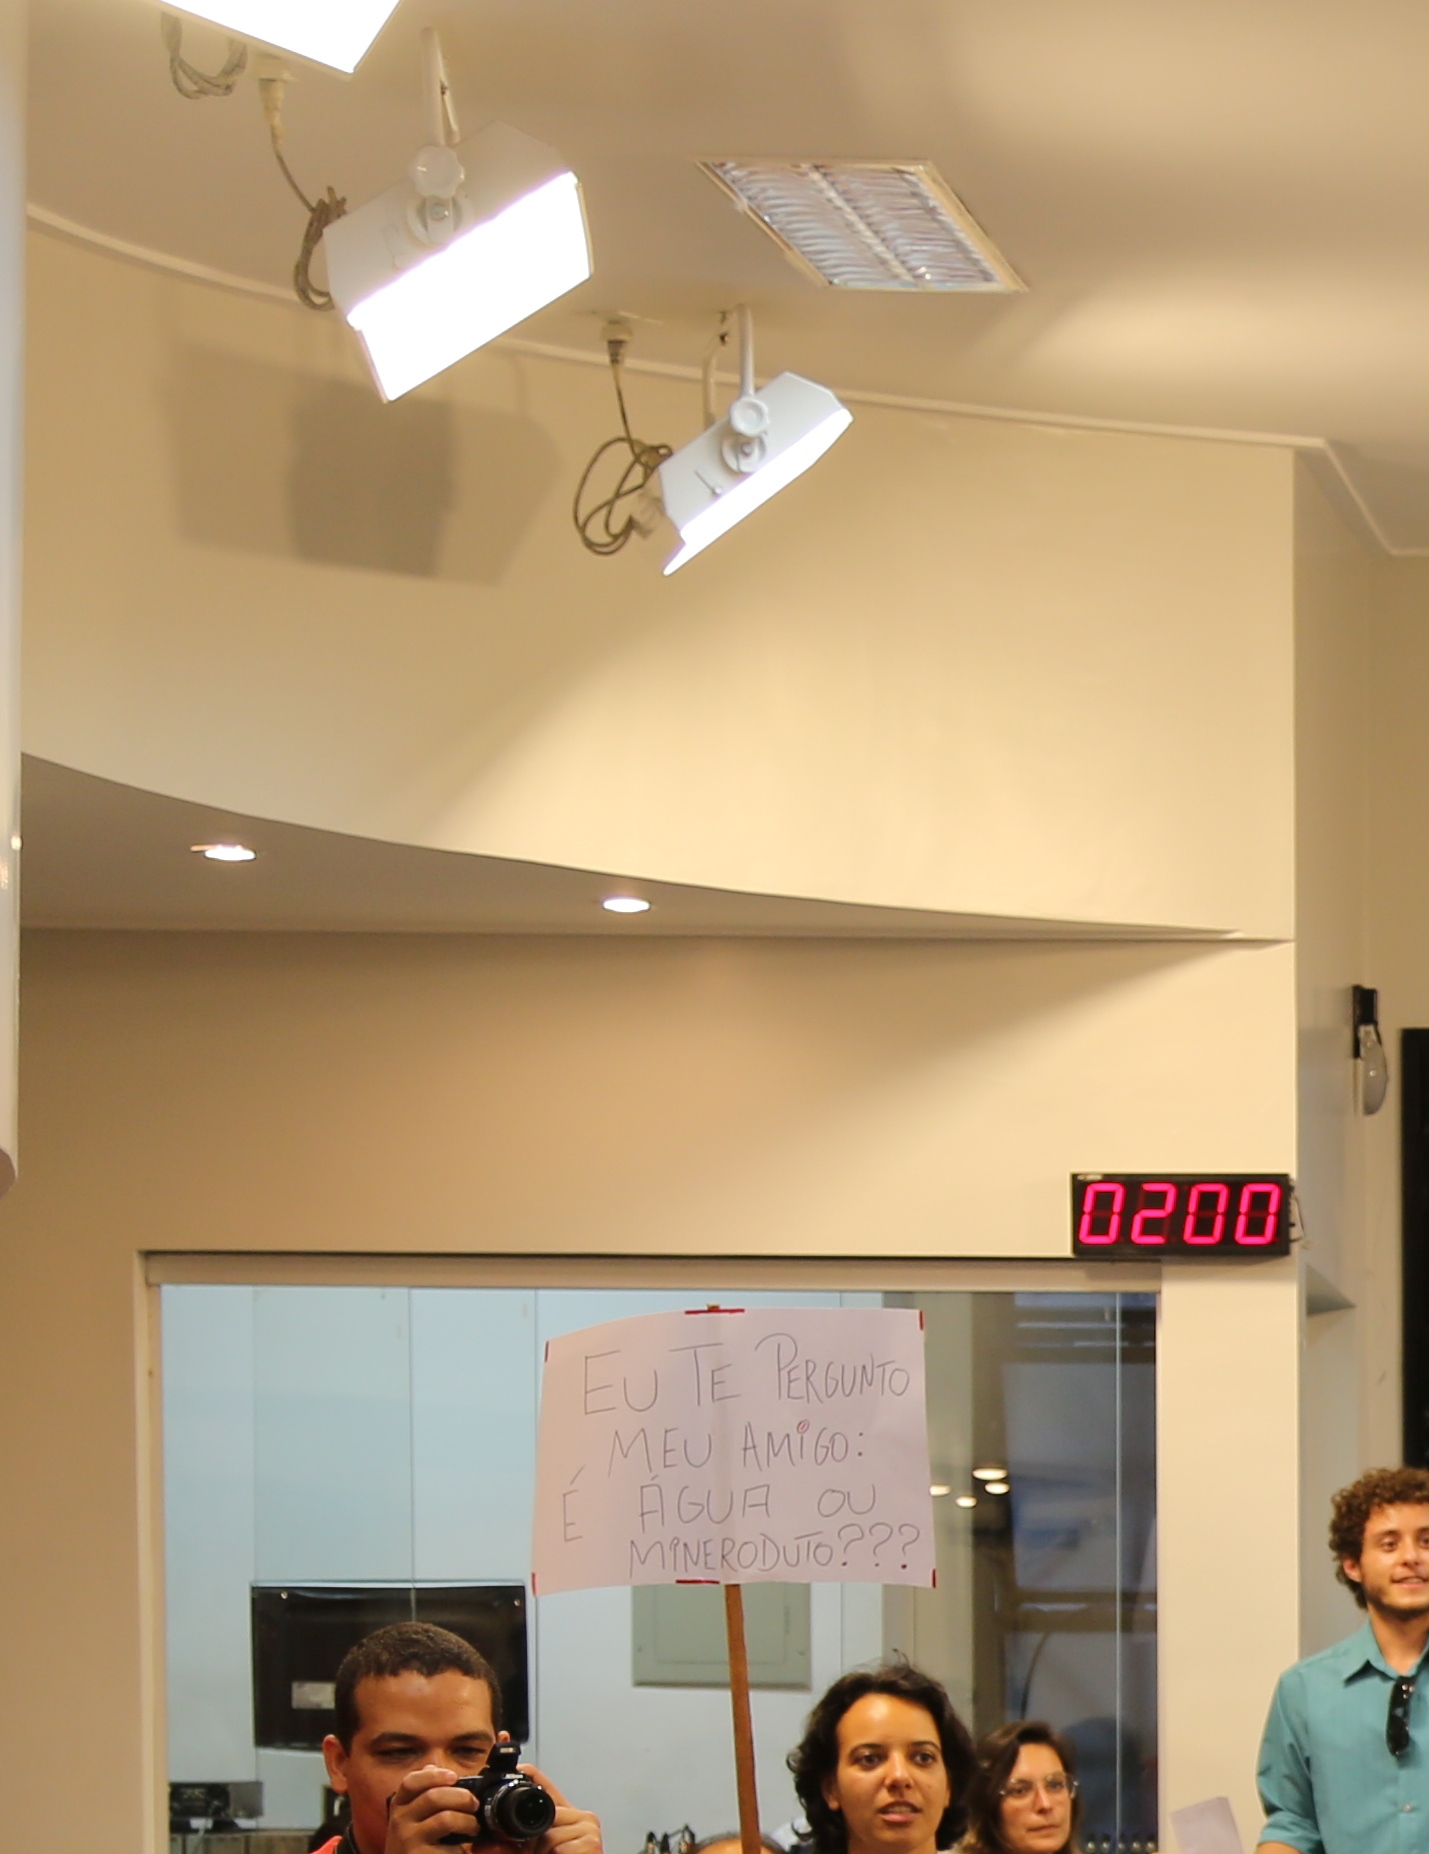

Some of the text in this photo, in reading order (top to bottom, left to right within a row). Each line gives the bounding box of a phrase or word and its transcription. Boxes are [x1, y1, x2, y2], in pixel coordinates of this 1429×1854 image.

[1078, 1182, 1282, 1245] 0200
[584, 1333, 910, 1415] EU TE PERGUNTO
[608, 1428, 713, 1478] MEU
[562, 1465, 876, 1543] É ÁGUA OU
